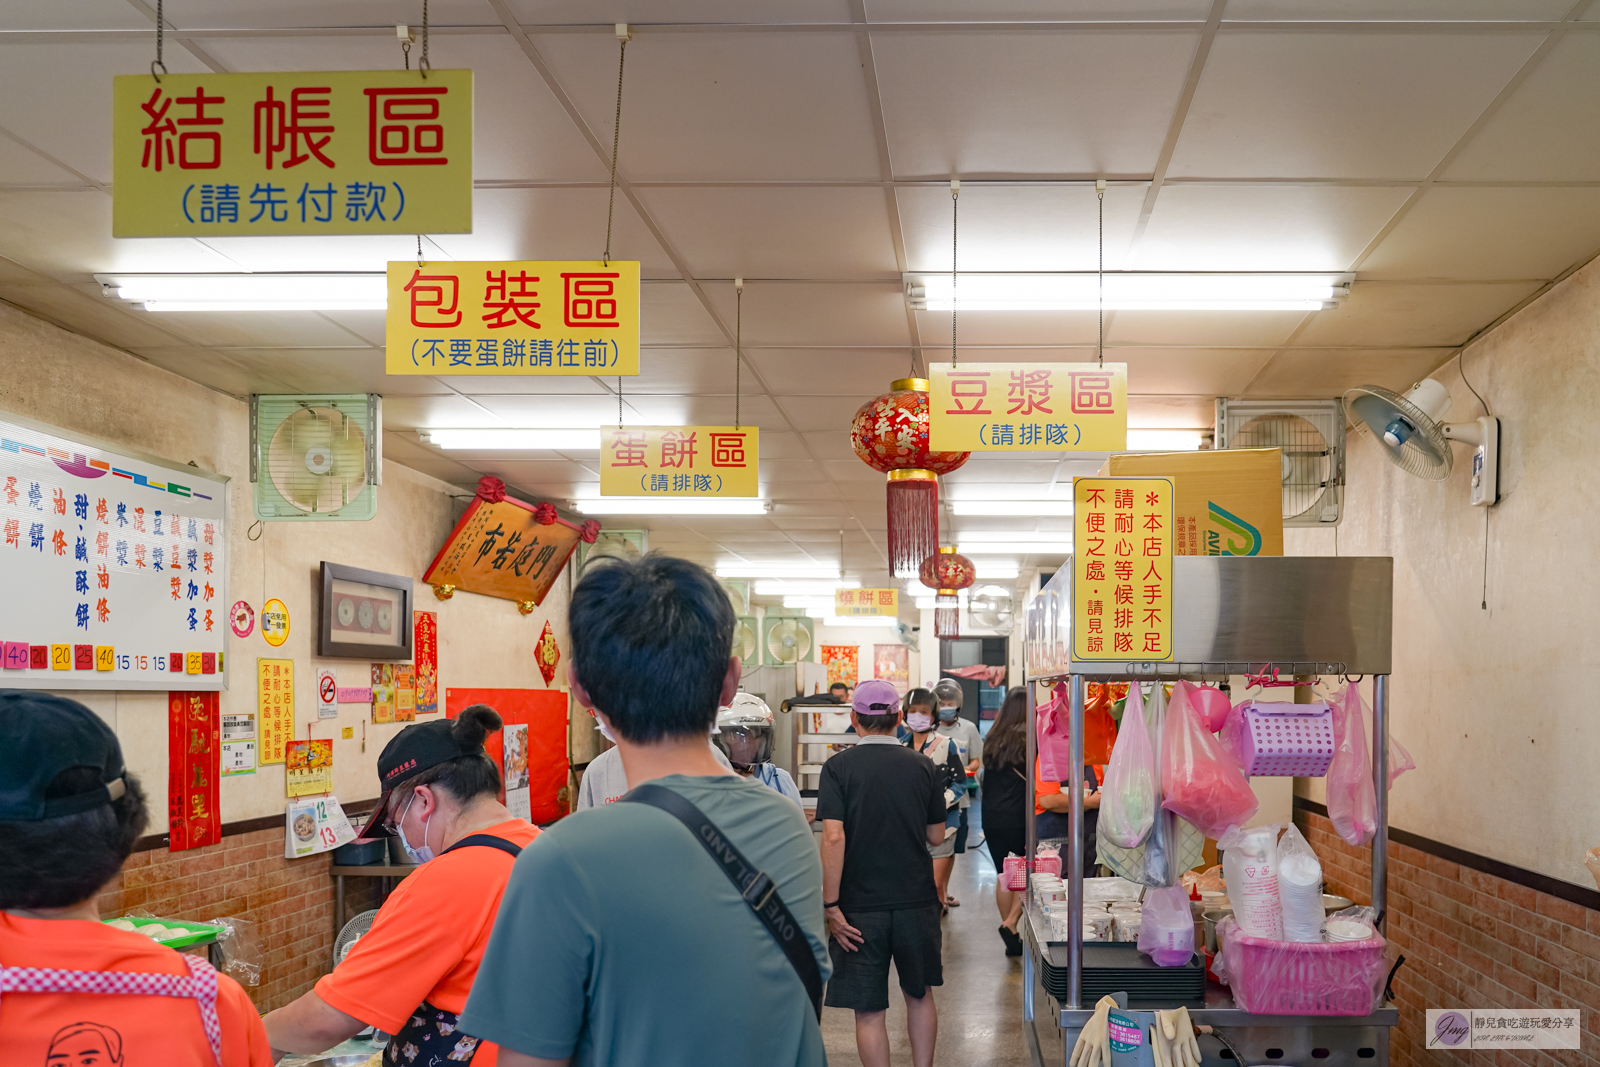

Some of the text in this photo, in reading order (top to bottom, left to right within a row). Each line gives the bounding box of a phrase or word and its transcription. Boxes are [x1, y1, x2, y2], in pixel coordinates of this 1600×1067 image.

[141, 86, 448, 171] 結帳區
[182, 182, 405, 223] (請先付款)
[403, 269, 620, 329] 包裝區
[411, 338, 619, 367] (不要蛋餅請往前)
[945, 370, 1114, 415] 豆漿區
[979, 424, 1081, 446] (請排隊)
[610, 431, 747, 468] 蛋餅區
[641, 474, 723, 492] (請排隊)
[4, 476, 20, 549] 蛋餅
[52, 488, 68, 556] 油條
[95, 497, 111, 623] 燒餅油條
[1114, 488, 1134, 653] 請耐心等候排隊
[839, 590, 894, 606] 燒餅區
[8, 646, 28, 665] 40
[55, 646, 70, 664] 20
[77, 646, 92, 664] 25
[100, 649, 114, 665] 40
[116, 655, 130, 670] 15
[135, 656, 148, 670] 15
[152, 656, 165, 671] 15
[172, 655, 182, 669] 20
[190, 654, 201, 670] 35
[204, 655, 215, 671] 30
[316, 800, 328, 820] 12
[320, 827, 337, 845] 13
